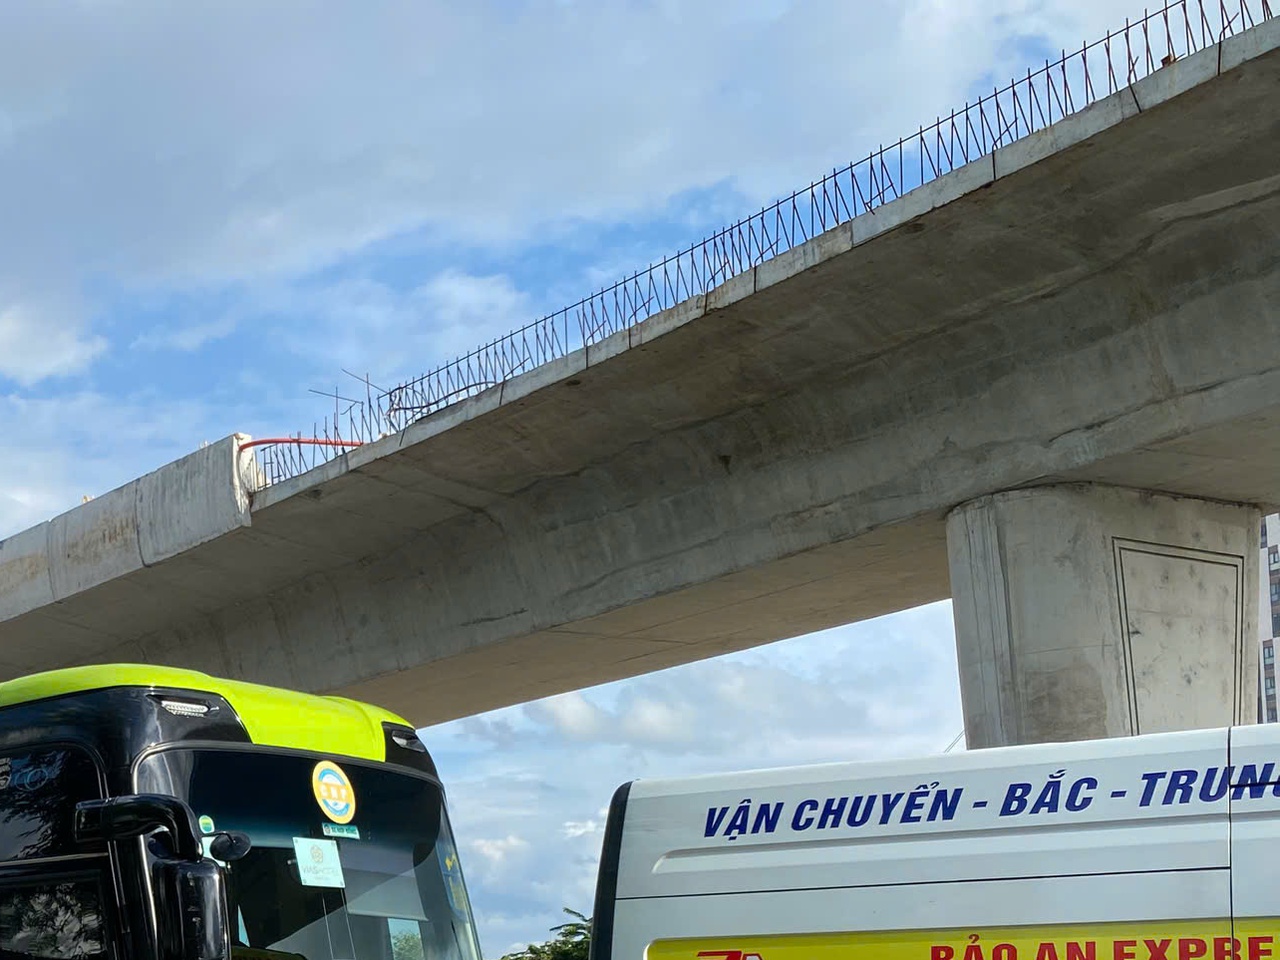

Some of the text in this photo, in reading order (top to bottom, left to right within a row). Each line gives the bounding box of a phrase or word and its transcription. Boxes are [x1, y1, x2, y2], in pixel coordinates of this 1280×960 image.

[704, 799, 784, 841] VẬN
[791, 781, 964, 831] CHUYỂN
[999, 769, 1098, 817] BẮC
